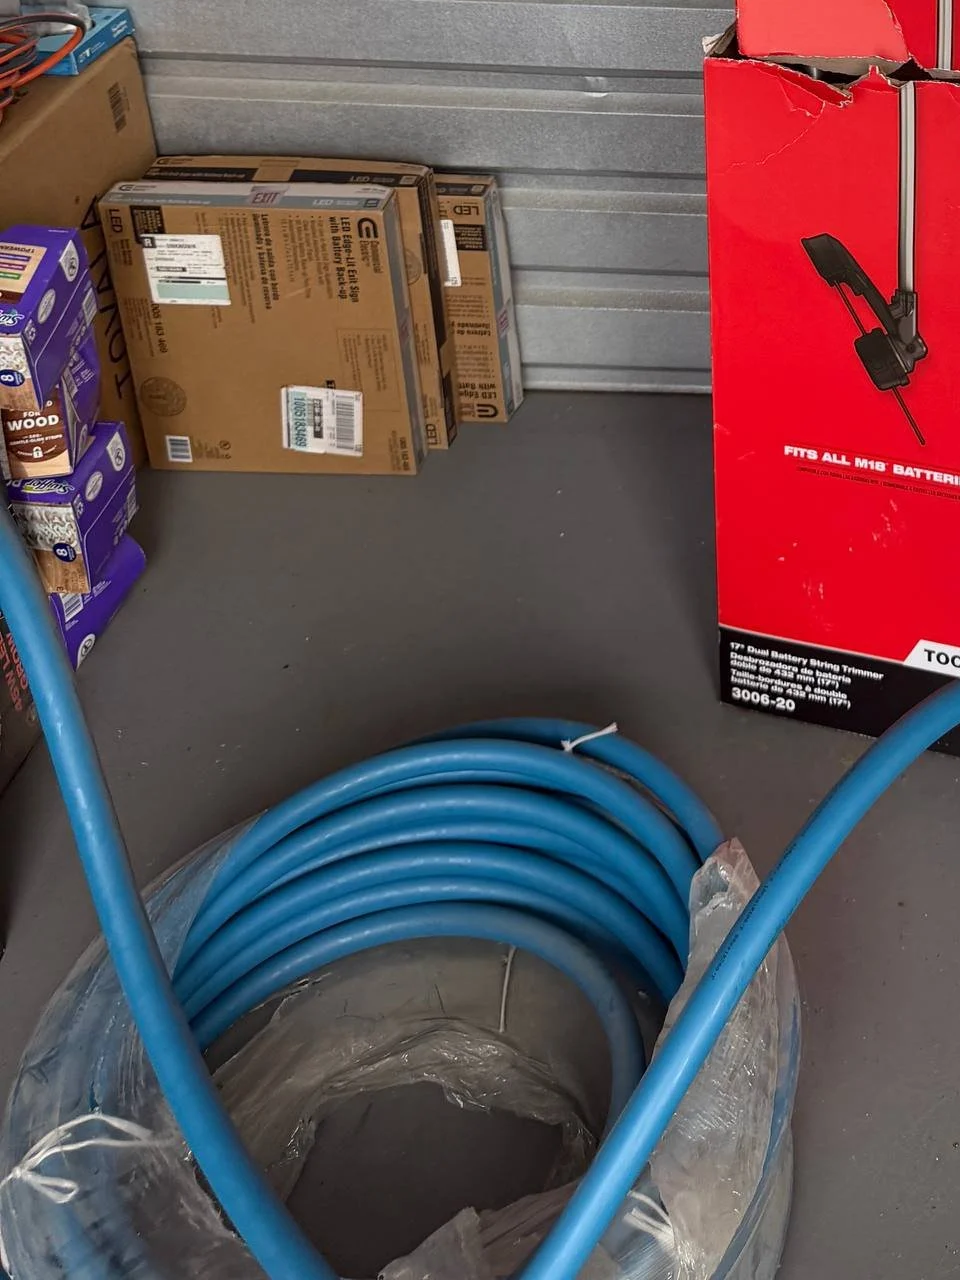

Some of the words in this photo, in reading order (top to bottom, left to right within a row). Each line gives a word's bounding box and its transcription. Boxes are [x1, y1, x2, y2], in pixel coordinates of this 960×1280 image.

[350, 175, 370, 184] LED
[252, 192, 278, 204] EXIT
[312, 198, 334, 207] LED
[452, 204, 480, 216] LED
[109, 208, 122, 232] LED
[329, 216, 341, 234] with
[340, 217, 351, 232] LED
[332, 236, 344, 265] Battery
[342, 234, 357, 268] Edge-Lit
[336, 266, 348, 300] Back-up
[347, 270, 359, 284] Exit
[349, 286, 360, 303] Sign
[476, 382, 496, 390] with
[481, 391, 497, 399] LED
[6, 414, 60, 432] WOOD
[425, 423, 438, 445] LED
[784, 445, 818, 460] FITS
[822, 452, 851, 466] ALL
[854, 457, 887, 472] M18
[23, 479, 75, 494] Swiffer
[55, 547, 68, 557] 8
[730, 652, 799, 673] Desbrozadora
[800, 666, 814, 676] de
[730, 659, 758, 672] doble
[759, 664, 772, 674] de
[774, 668, 795, 679] 432
[796, 673, 815, 683] mm
[747, 645, 770, 658] Dual
[771, 648, 809, 666] Battery
[810, 658, 840, 673] String
[841, 664, 885, 681] Trimmer
[730, 668, 803, 690] Taille-bordures
[813, 687, 848, 700] double
[730, 676, 770, 690] batterie
[771, 684, 784, 694] de
[786, 687, 806, 699] 432
[808, 692, 827, 702] mm
[732, 686, 796, 712] 3006-20
